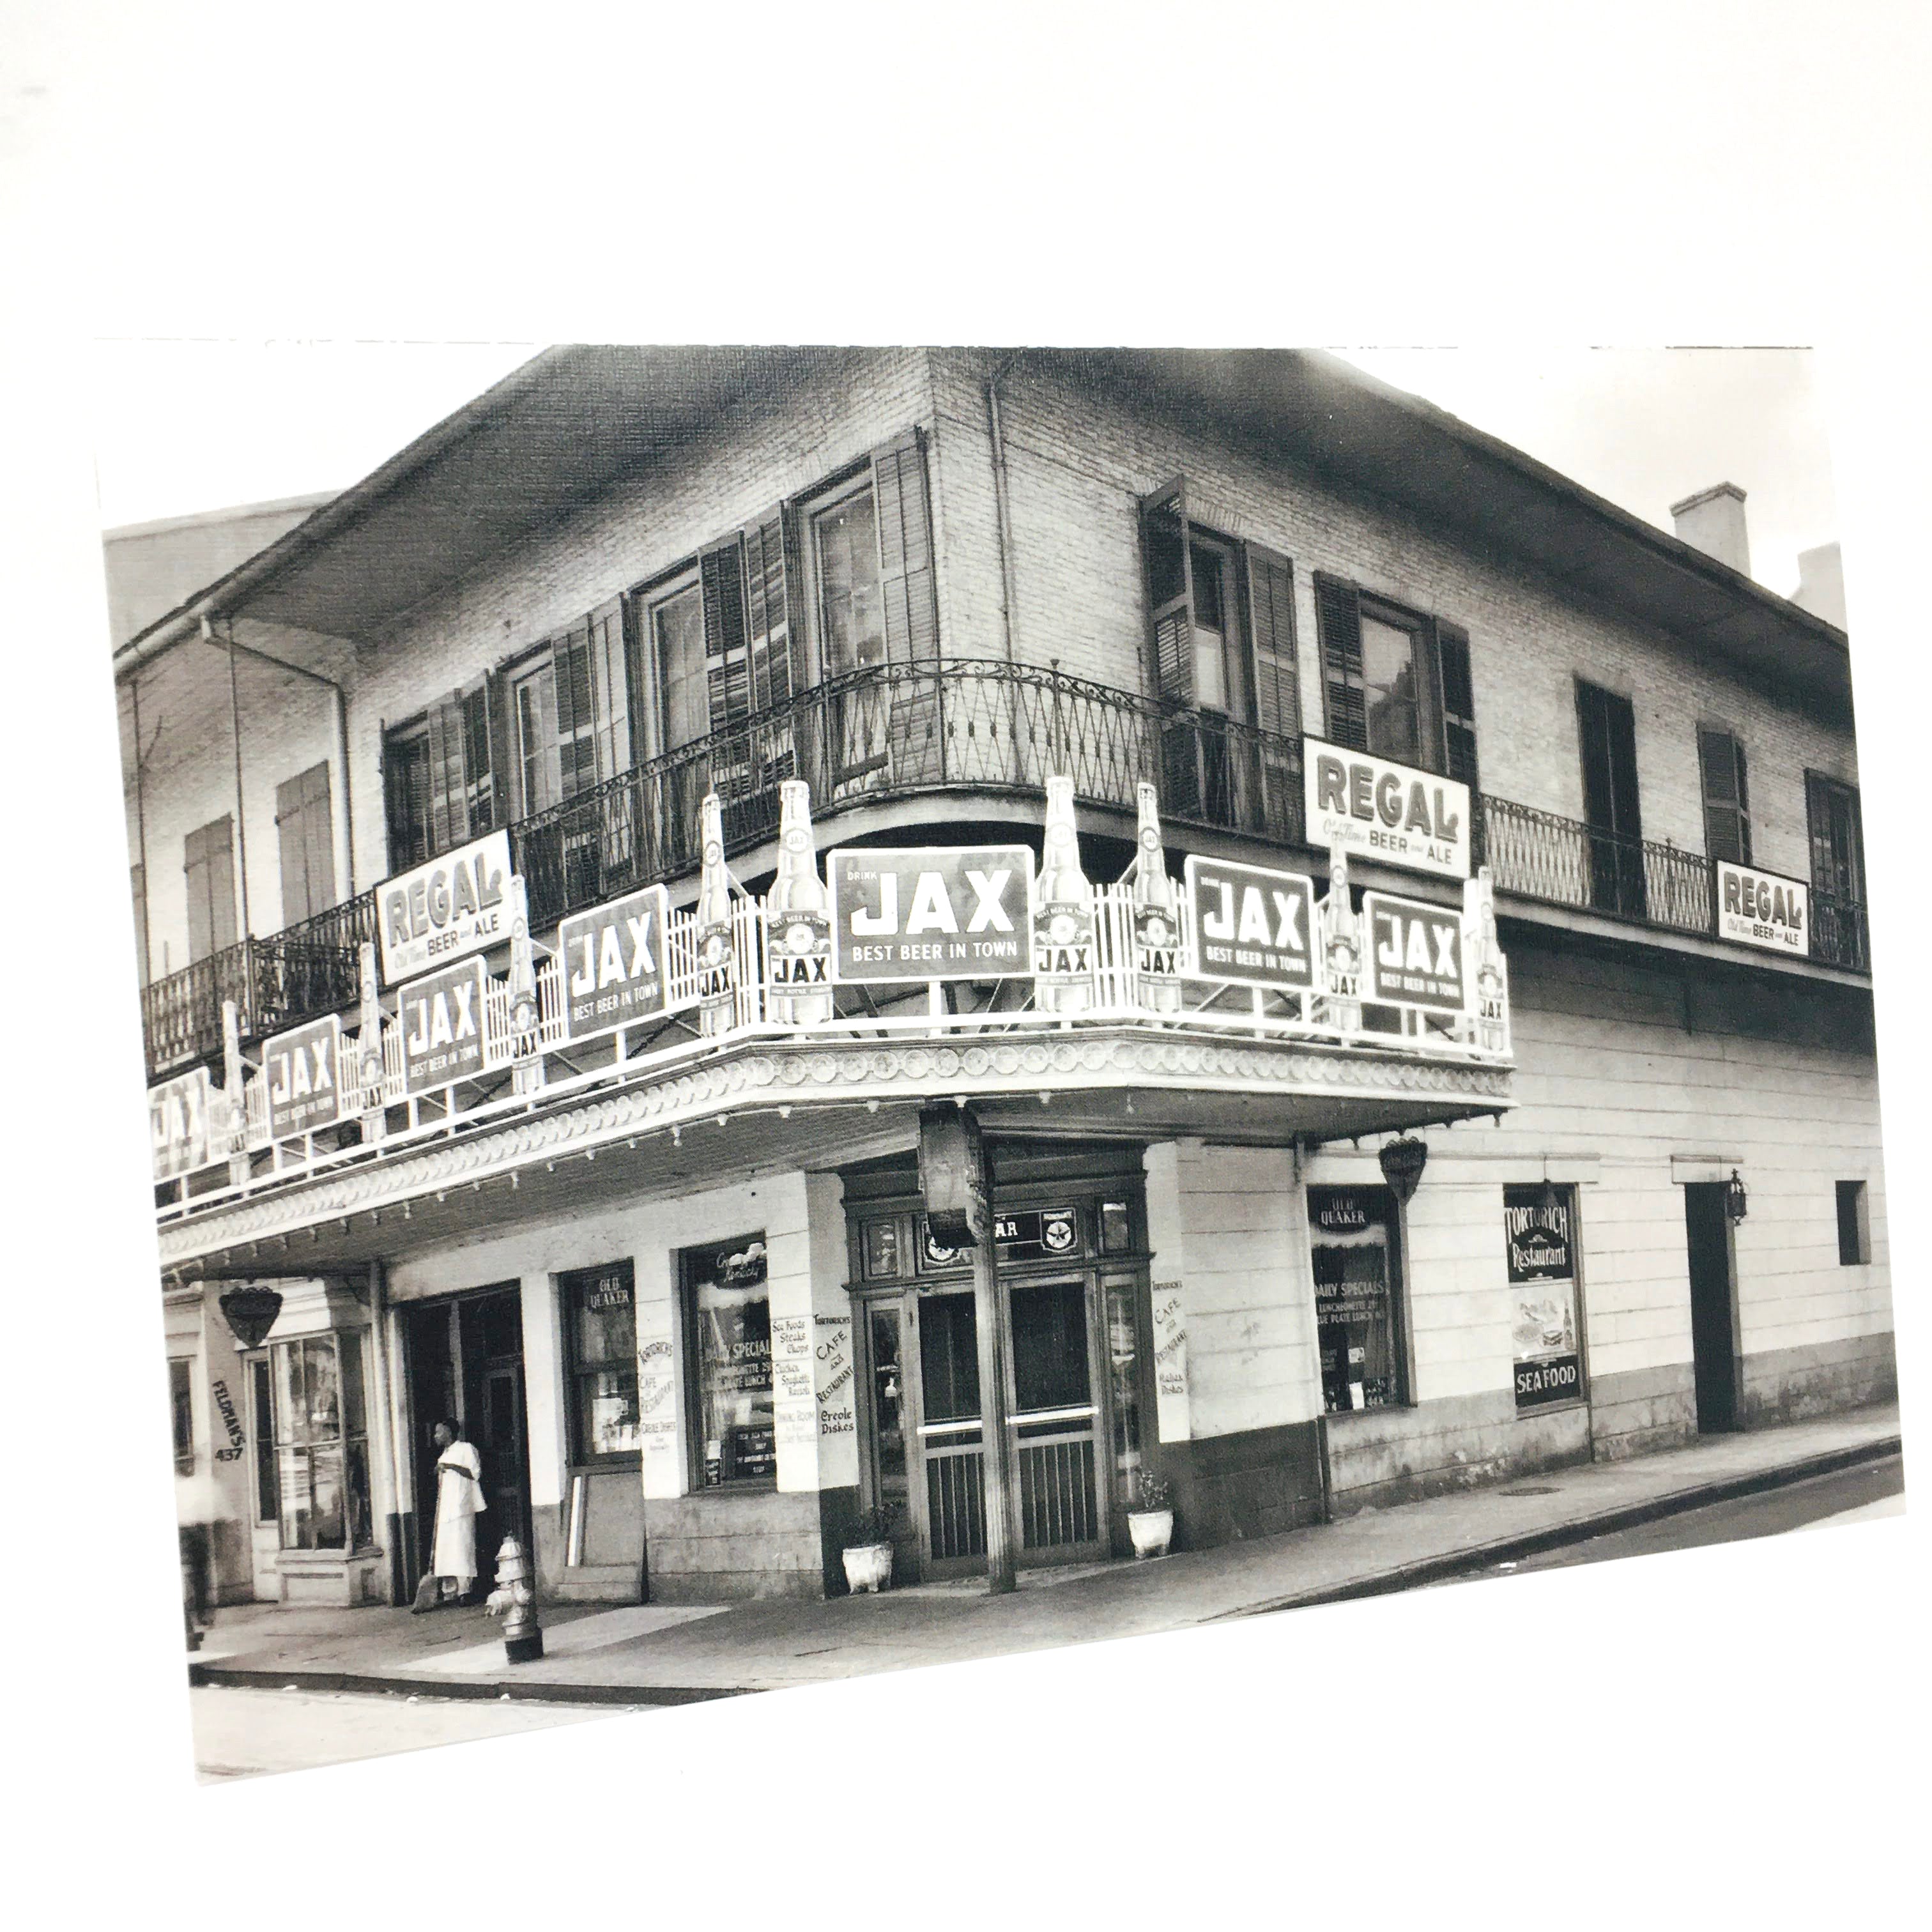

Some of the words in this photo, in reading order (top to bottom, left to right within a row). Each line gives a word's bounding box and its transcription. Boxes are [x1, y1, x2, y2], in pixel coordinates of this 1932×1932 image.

[1317, 754, 1459, 843] REGAL
[1369, 830, 1407, 854] BEER
[1427, 844, 1452, 864] ALE
[847, 870, 877, 881] DRINK
[386, 852, 503, 948] REGAL
[850, 870, 1015, 937] JAX
[1724, 871, 1802, 930] REGAL
[1203, 882, 1305, 951] JAX
[427, 930, 459, 956] BEER
[474, 913, 500, 939] ALE
[1378, 916, 1457, 979] JAX
[1753, 924, 1774, 940] BEER
[1783, 931, 1799, 946] ALE
[571, 911, 656, 997] JAX
[852, 946, 893, 962] BEST
[900, 944, 942, 960] BEER
[949, 942, 967, 959] IN
[973, 941, 1018, 958] TOWN
[1038, 947, 1087, 973] JAX
[1140, 949, 1176, 974] JAX
[1206, 946, 1233, 963] BEST
[1265, 954, 1277, 969] IN
[702, 965, 731, 997] JAX
[774, 957, 826, 983] JAX
[1331, 975, 1357, 997] JAX
[574, 1001, 595, 1021] BEST
[597, 994, 619, 1014] BEER
[620, 990, 632, 1006] IN
[634, 981, 658, 1002] TOWN
[1480, 999, 1501, 1020] JAX
[408, 981, 477, 1057] JAX
[513, 1032, 537, 1059] JAX
[272, 1037, 333, 1105] JAX
[994, 1221, 1018, 1238] AR
[1321, 1209, 1367, 1225] QUAKER
[1503, 1206, 1568, 1244] TORTORICH
[1512, 1242, 1566, 1273] Restaurant
[590, 1289, 629, 1309] QUAKER
[1341, 1280, 1384, 1296] SPECIALS
[1154, 1298, 1181, 1325] CAFE
[772, 1320, 784, 1333] Sea
[786, 1319, 805, 1331] Foods
[779, 1332, 806, 1343] Steaks
[786, 1344, 809, 1355] Chops
[816, 1330, 848, 1360] CAFE
[815, 1365, 854, 1404] RESTAURANT
[1517, 1365, 1576, 1394] SEAFOOD
[821, 1407, 852, 1422] Creole
[822, 1421, 855, 1435] Dishes
[215, 1447, 243, 1462] 437
